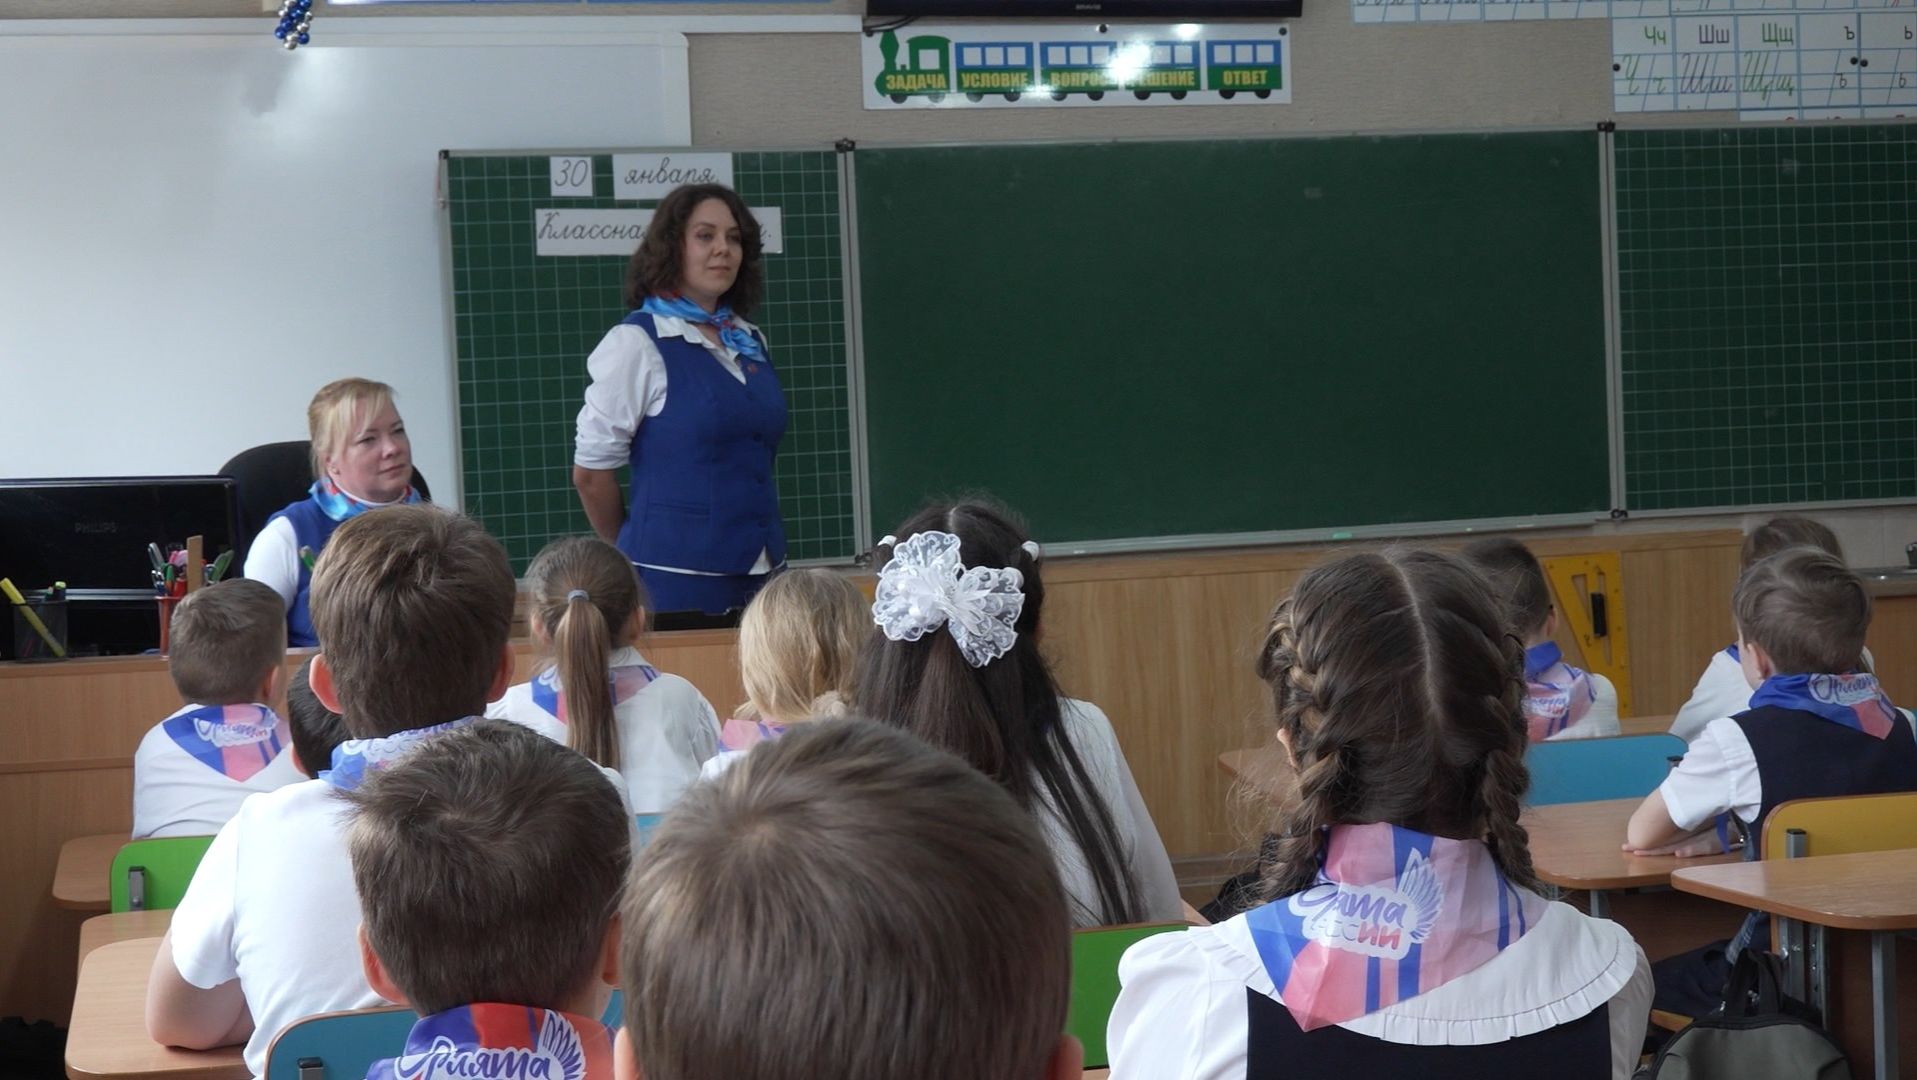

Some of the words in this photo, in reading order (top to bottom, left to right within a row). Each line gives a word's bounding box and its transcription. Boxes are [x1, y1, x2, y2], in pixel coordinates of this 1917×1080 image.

[1644, 26, 1666, 46] Чч
[1699, 24, 1730, 44] Шш
[1762, 22, 1793, 47] Щщ
[886, 73, 947, 91] ЗАДАЧА
[961, 72, 1028, 89] УСЛОВИЕ
[1131, 70, 1195, 88] ЕШЕНИЕ
[1223, 69, 1267, 86] ОТВЕТ
[554, 159, 589, 188] 30
[75, 522, 118, 534] PHILIPS
